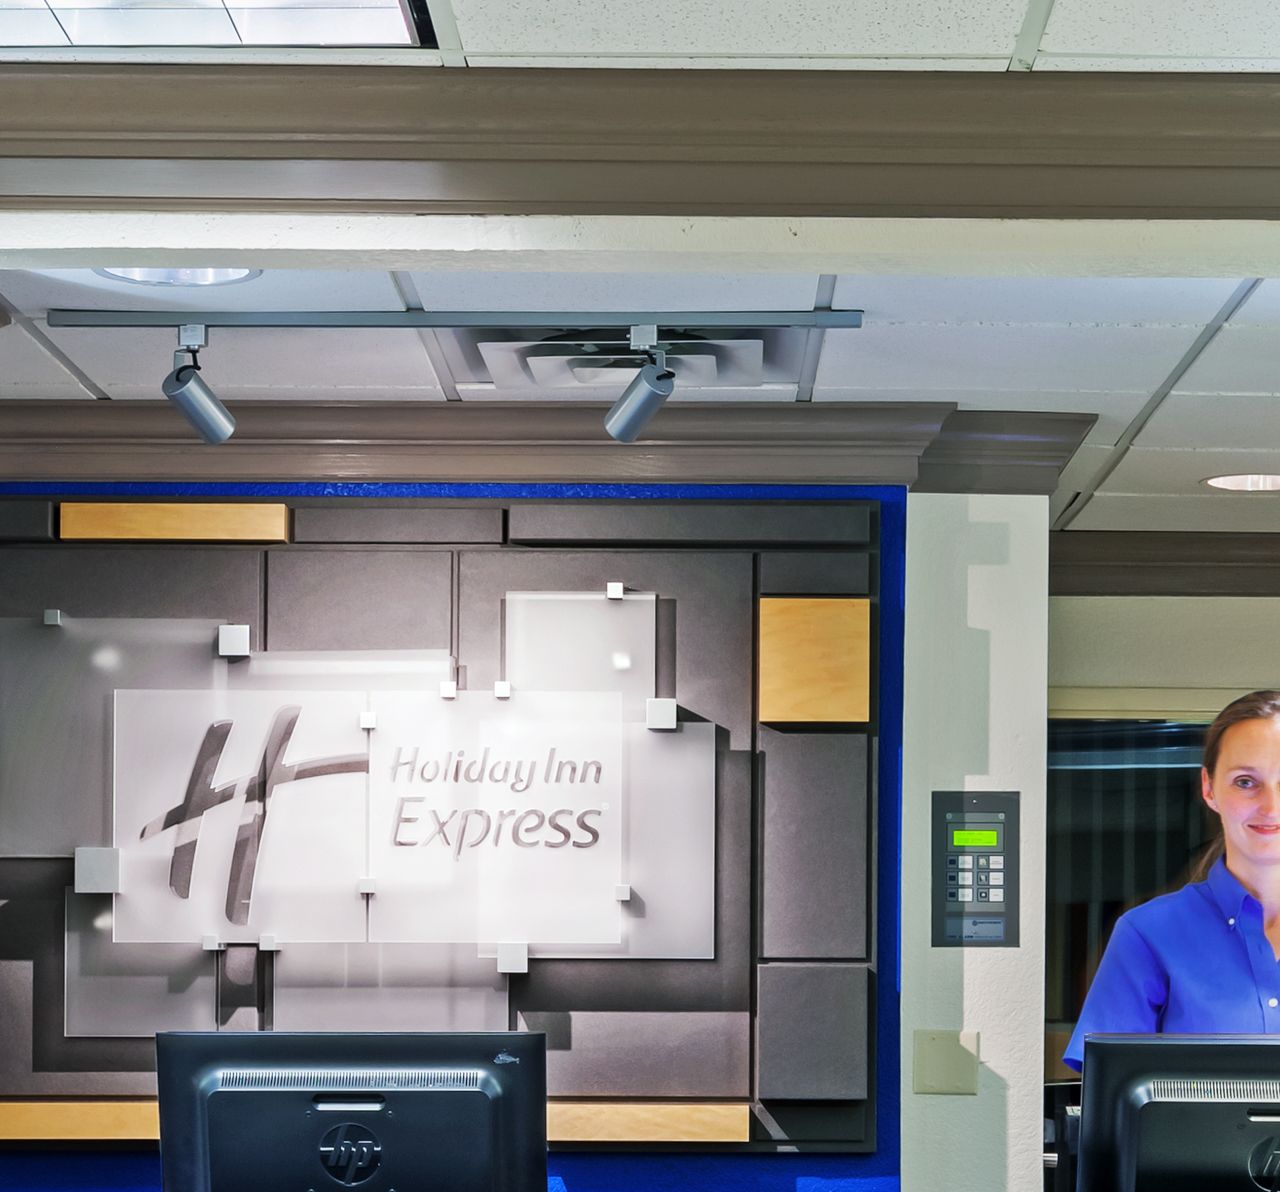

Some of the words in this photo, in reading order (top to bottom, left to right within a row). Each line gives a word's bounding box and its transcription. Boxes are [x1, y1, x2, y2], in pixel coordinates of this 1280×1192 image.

[391, 747, 536, 792] Holiday
[544, 747, 602, 784] Inn
[391, 797, 602, 861] Express
